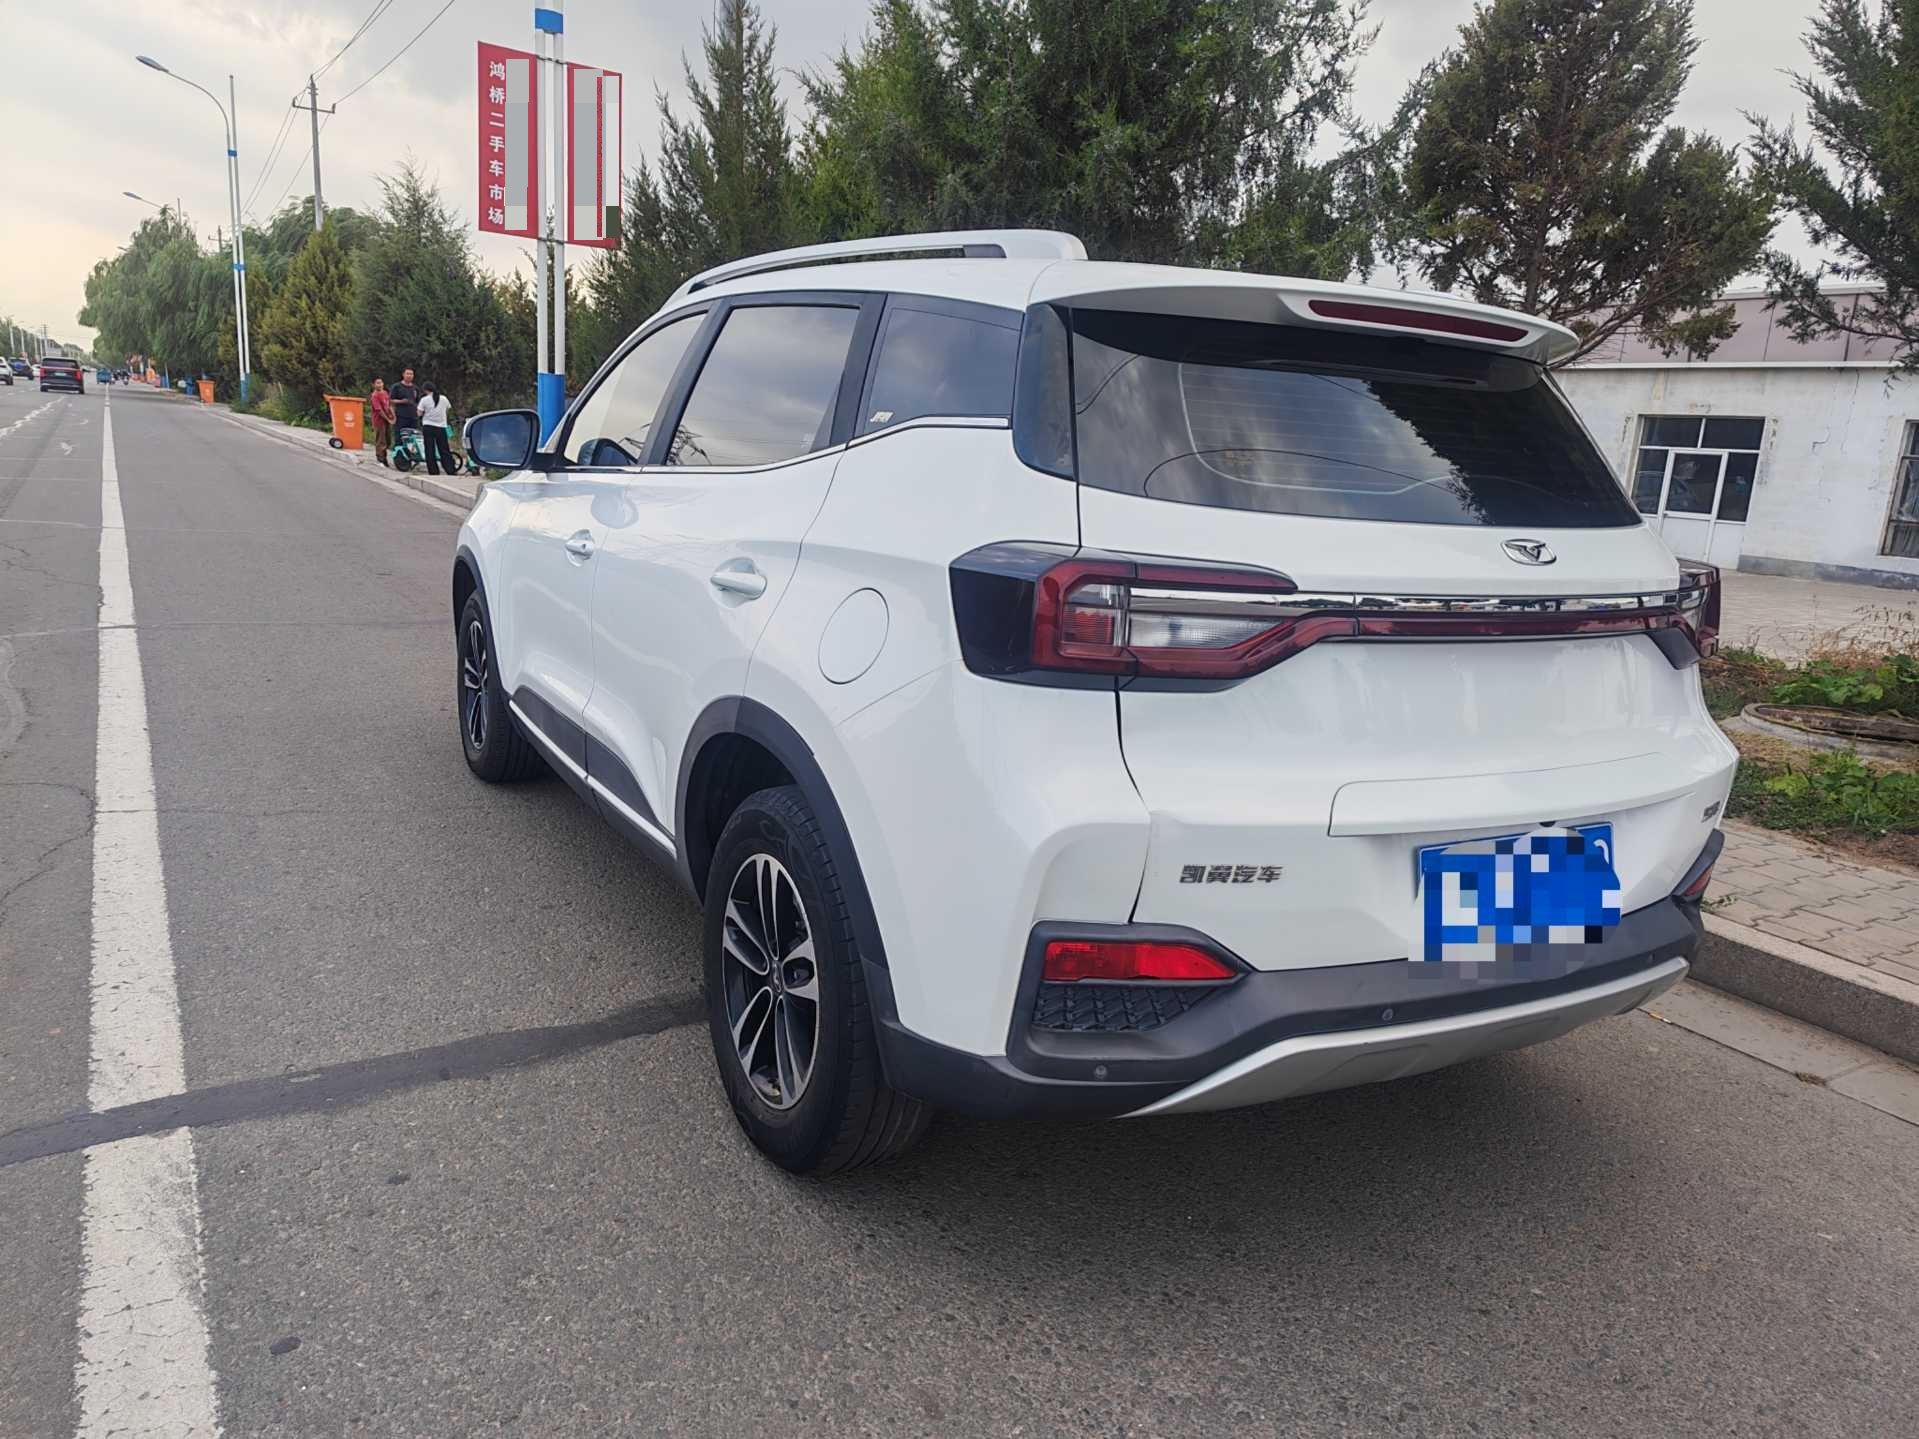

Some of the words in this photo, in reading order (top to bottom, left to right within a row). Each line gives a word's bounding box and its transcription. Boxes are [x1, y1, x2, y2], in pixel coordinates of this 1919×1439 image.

[488, 61, 505, 225] 鸿桥二手车市场
[1179, 864, 1283, 884] 凯翼汽车
